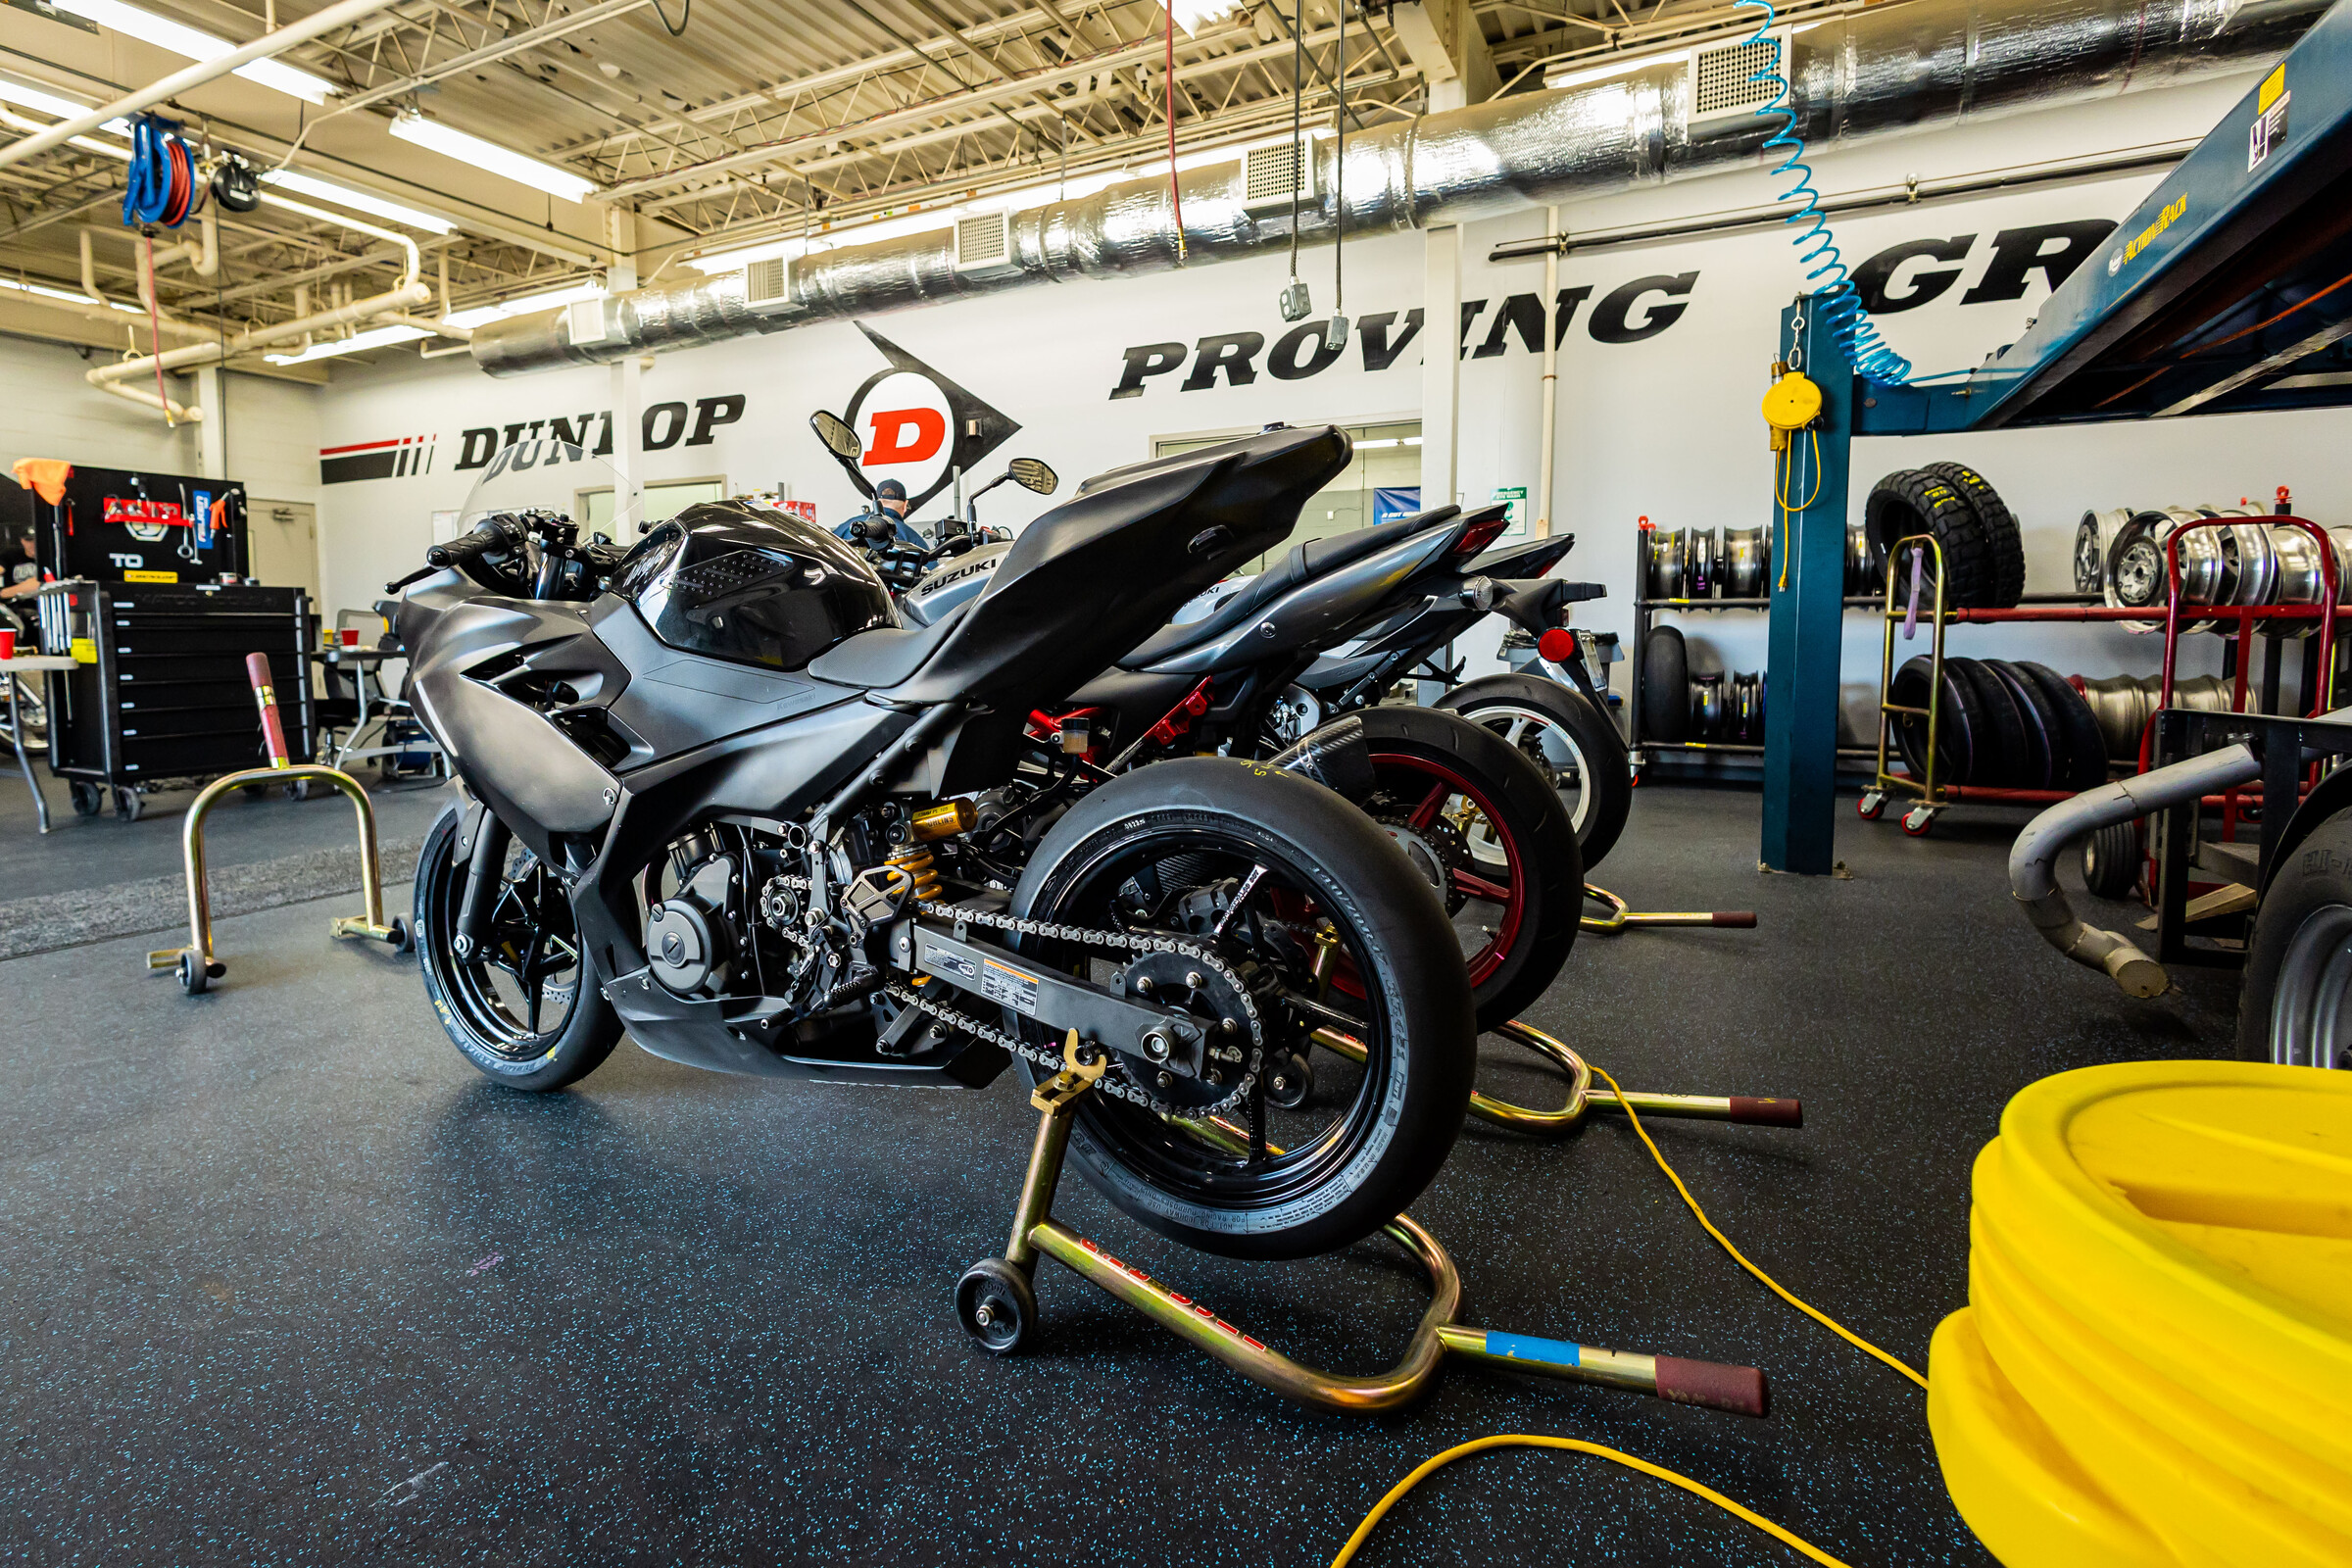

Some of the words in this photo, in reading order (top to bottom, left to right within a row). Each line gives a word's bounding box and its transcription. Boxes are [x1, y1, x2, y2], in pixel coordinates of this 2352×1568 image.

[454, 394, 746, 474] DUNLOP
[862, 408, 946, 466] D
[921, 559, 997, 596] SUZUKI
[1183, 586, 1220, 608] UKI
